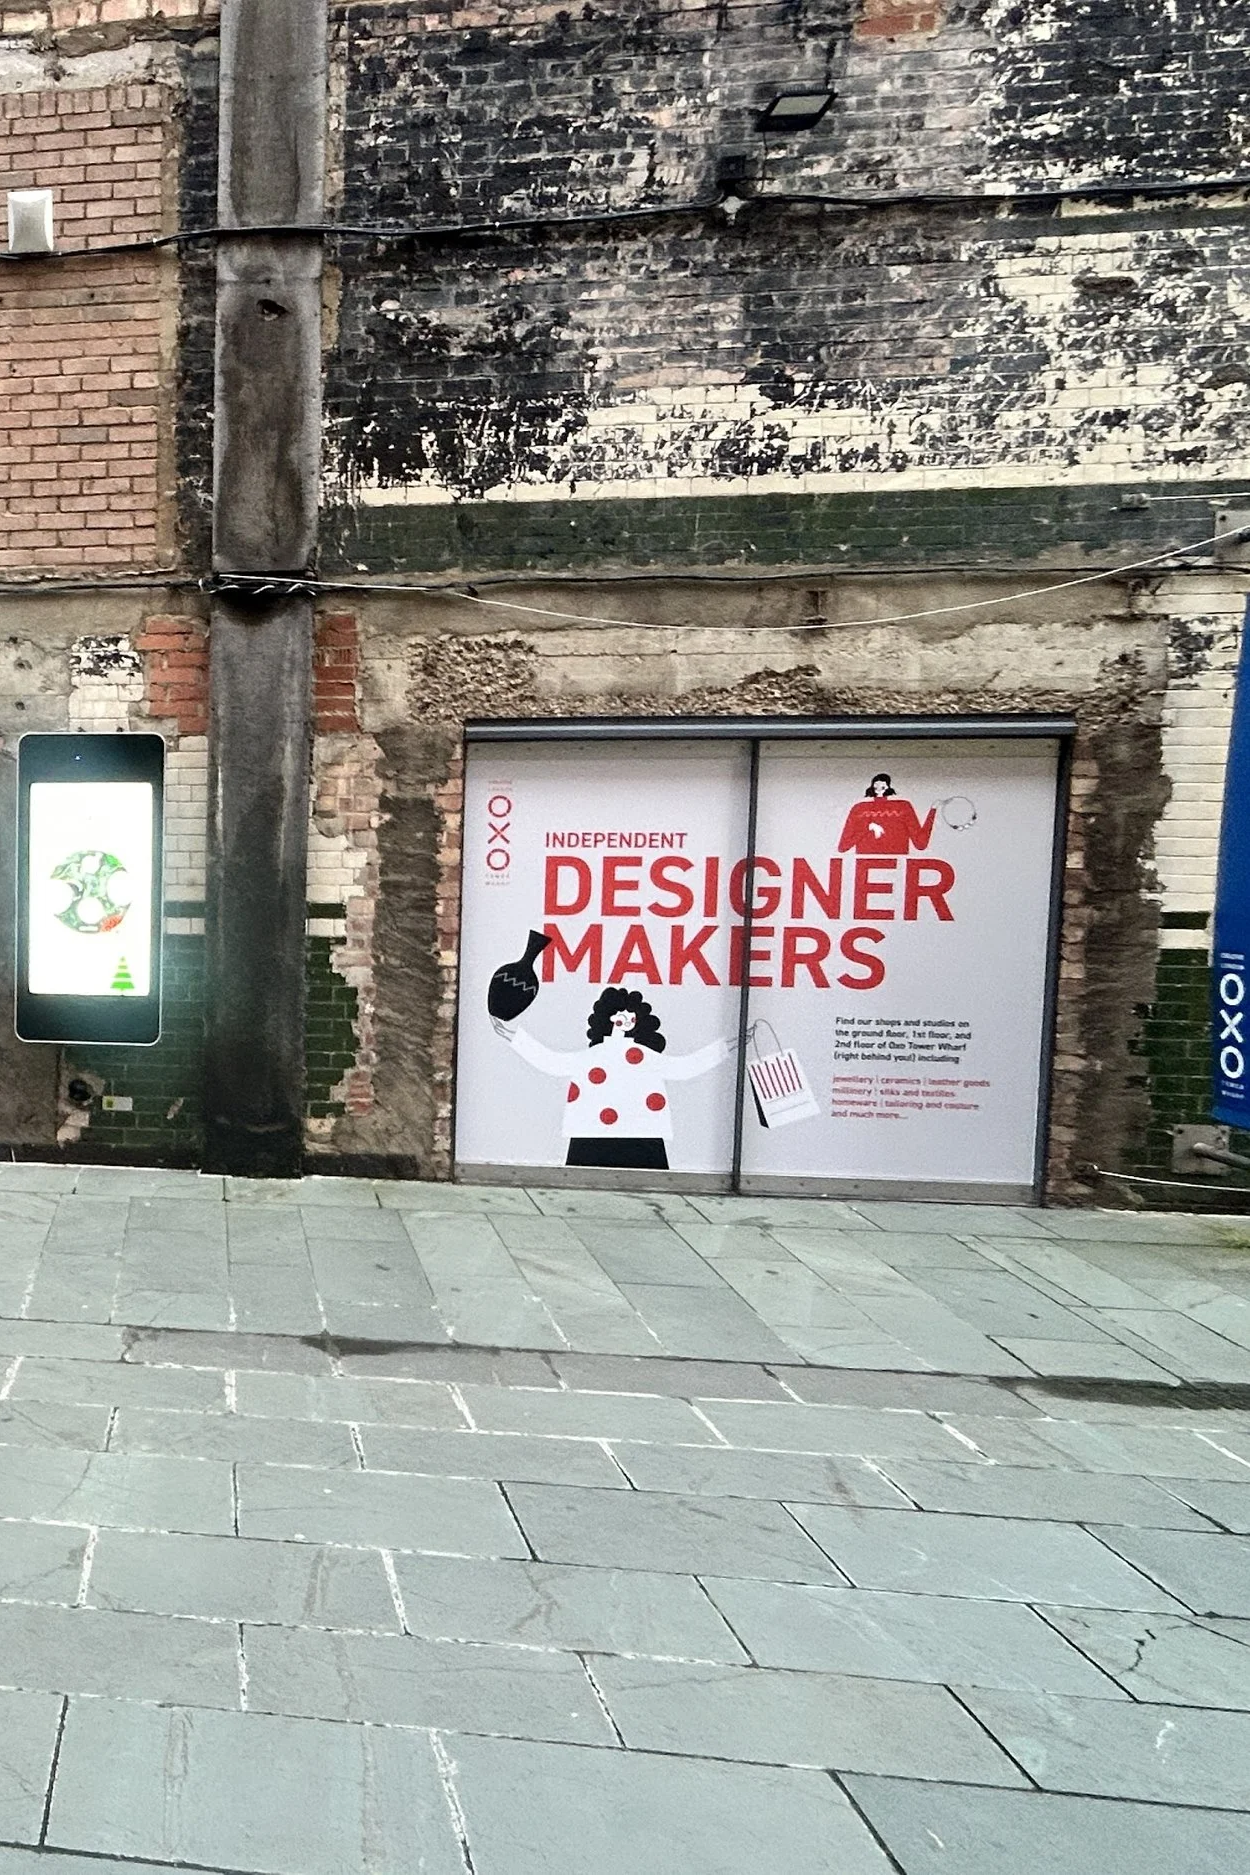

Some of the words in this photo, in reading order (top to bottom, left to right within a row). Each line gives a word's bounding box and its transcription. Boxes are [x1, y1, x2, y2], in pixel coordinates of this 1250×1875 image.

[486, 795, 512, 871] OXO
[545, 831, 688, 850] INDEPENDENT
[543, 855, 956, 921] DESIGNER
[542, 923, 887, 991] MAKERS
[836, 1017, 854, 1025] Find
[875, 1018, 901, 1028] shops
[904, 1019, 920, 1027] and
[1219, 973, 1245, 1079] OXO
[835, 1029, 849, 1037] the
[852, 1030, 883, 1039] ground
[955, 1031, 972, 1040] and
[835, 1040, 851, 1048] 2nd
[854, 1040, 875, 1049] floor
[878, 1041, 886, 1049] of
[909, 1042, 935, 1050] Tower
[861, 1053, 891, 1061] behind
